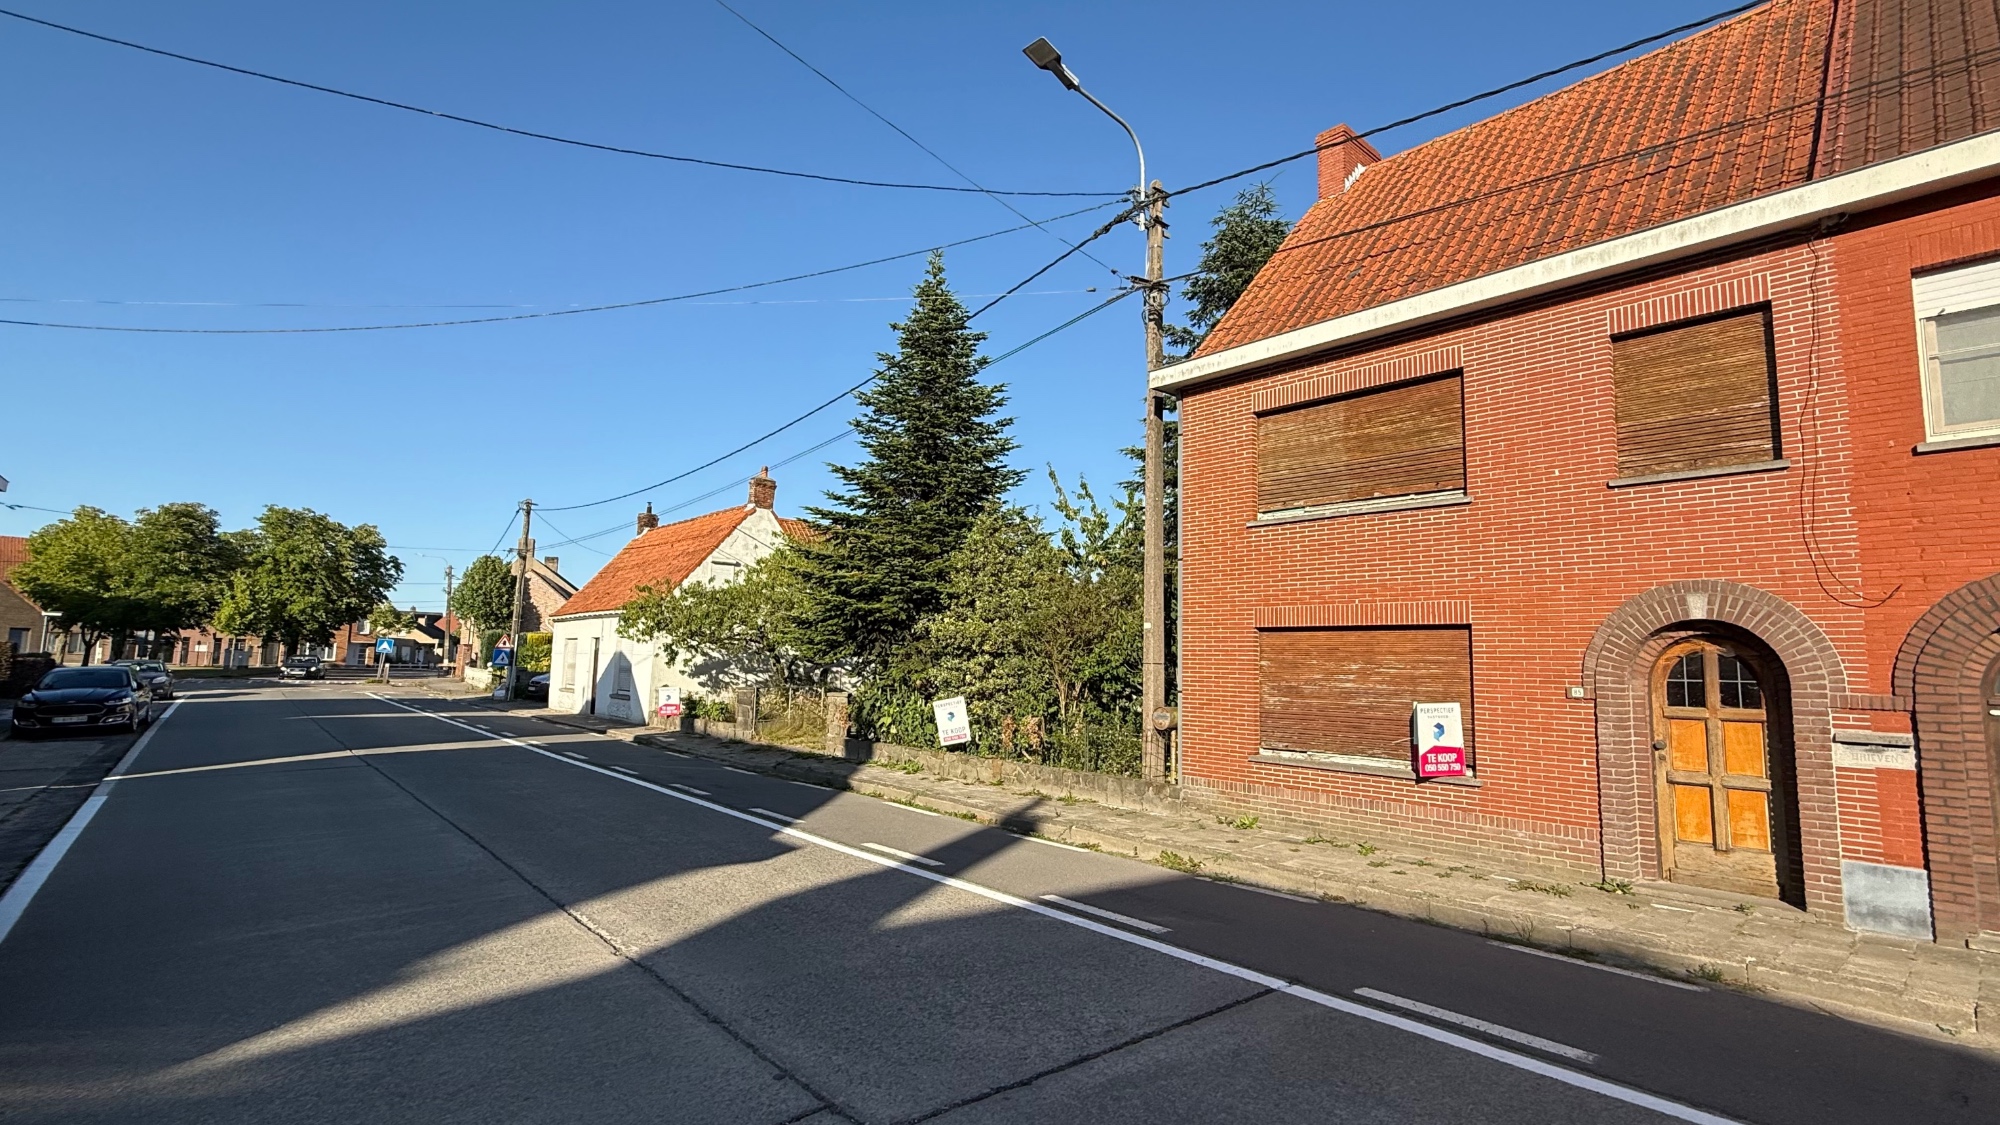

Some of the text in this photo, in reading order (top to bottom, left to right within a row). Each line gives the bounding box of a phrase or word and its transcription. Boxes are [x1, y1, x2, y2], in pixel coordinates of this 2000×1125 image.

[1427, 753, 1457, 763] TE KOOP
[1425, 764, 1436, 772] 050
[1450, 763, 1461, 771] 750
